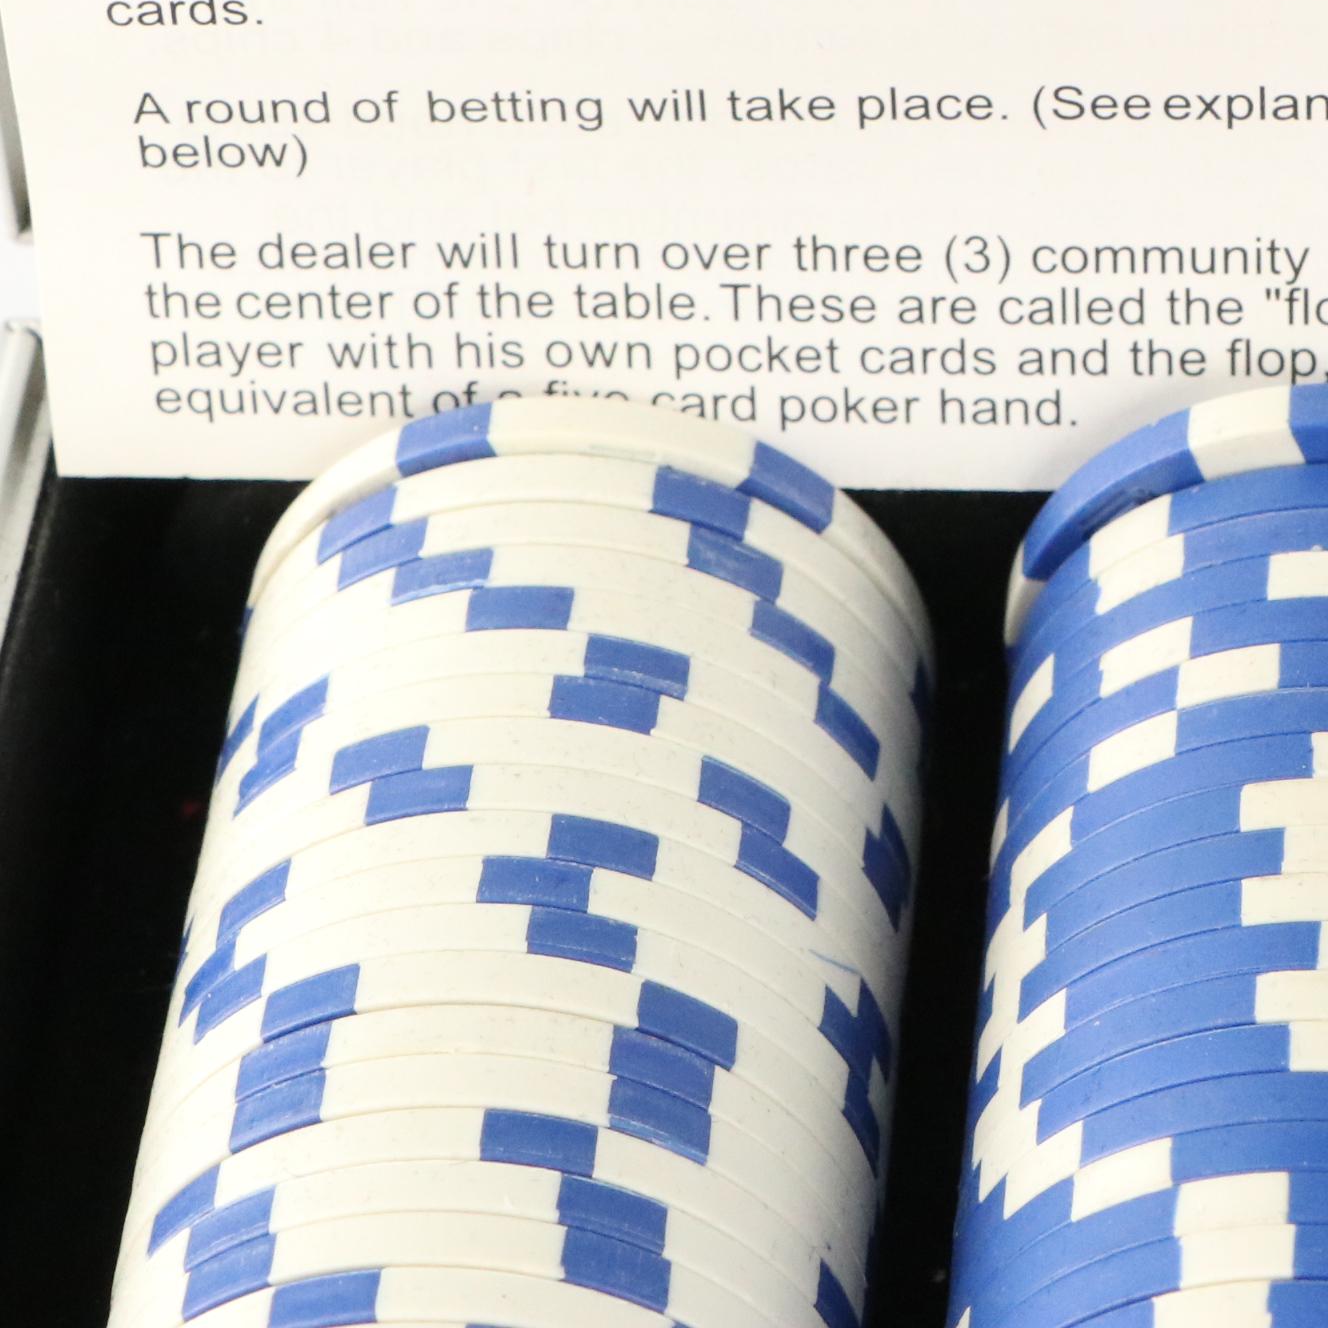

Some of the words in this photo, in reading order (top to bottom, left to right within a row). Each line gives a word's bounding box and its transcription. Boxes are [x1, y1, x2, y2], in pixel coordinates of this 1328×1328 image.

[133, 92, 170, 124] A
[186, 91, 331, 124] round
[352, 90, 399, 124] of
[427, 90, 603, 132] betting
[627, 89, 707, 122] will
[727, 87, 836, 122] take
[857, 86, 1008, 130] place.
[1032, 85, 1151, 130] (See
[138, 135, 308, 177] below)
[140, 232, 236, 270] The
[258, 232, 416, 270] dealer
[436, 232, 518, 269] will
[543, 235, 640, 270] turn
[661, 242, 771, 271] over
[793, 234, 922, 273] three
[945, 235, 1011, 284] (3)
[1032, 236, 1310, 286] community
[145, 282, 221, 319] the
[236, 284, 393, 320] center
[413, 281, 459, 320] of
[477, 282, 554, 319] the
[898, 295, 977, 325] are
[998, 287, 1145, 326] called
[1166, 287, 1244, 326] the
[151, 332, 303, 377] player
[327, 332, 433, 369] with
[455, 332, 524, 369] his
[545, 340, 651, 369] own
[674, 335, 840, 380] pocket
[860, 337, 997, 376] cards
[1018, 338, 1108, 376] and
[1129, 338, 1207, 378] the
[155, 381, 416, 423] equivalent
[780, 387, 920, 432] poker
[940, 388, 1077, 427] hand.
